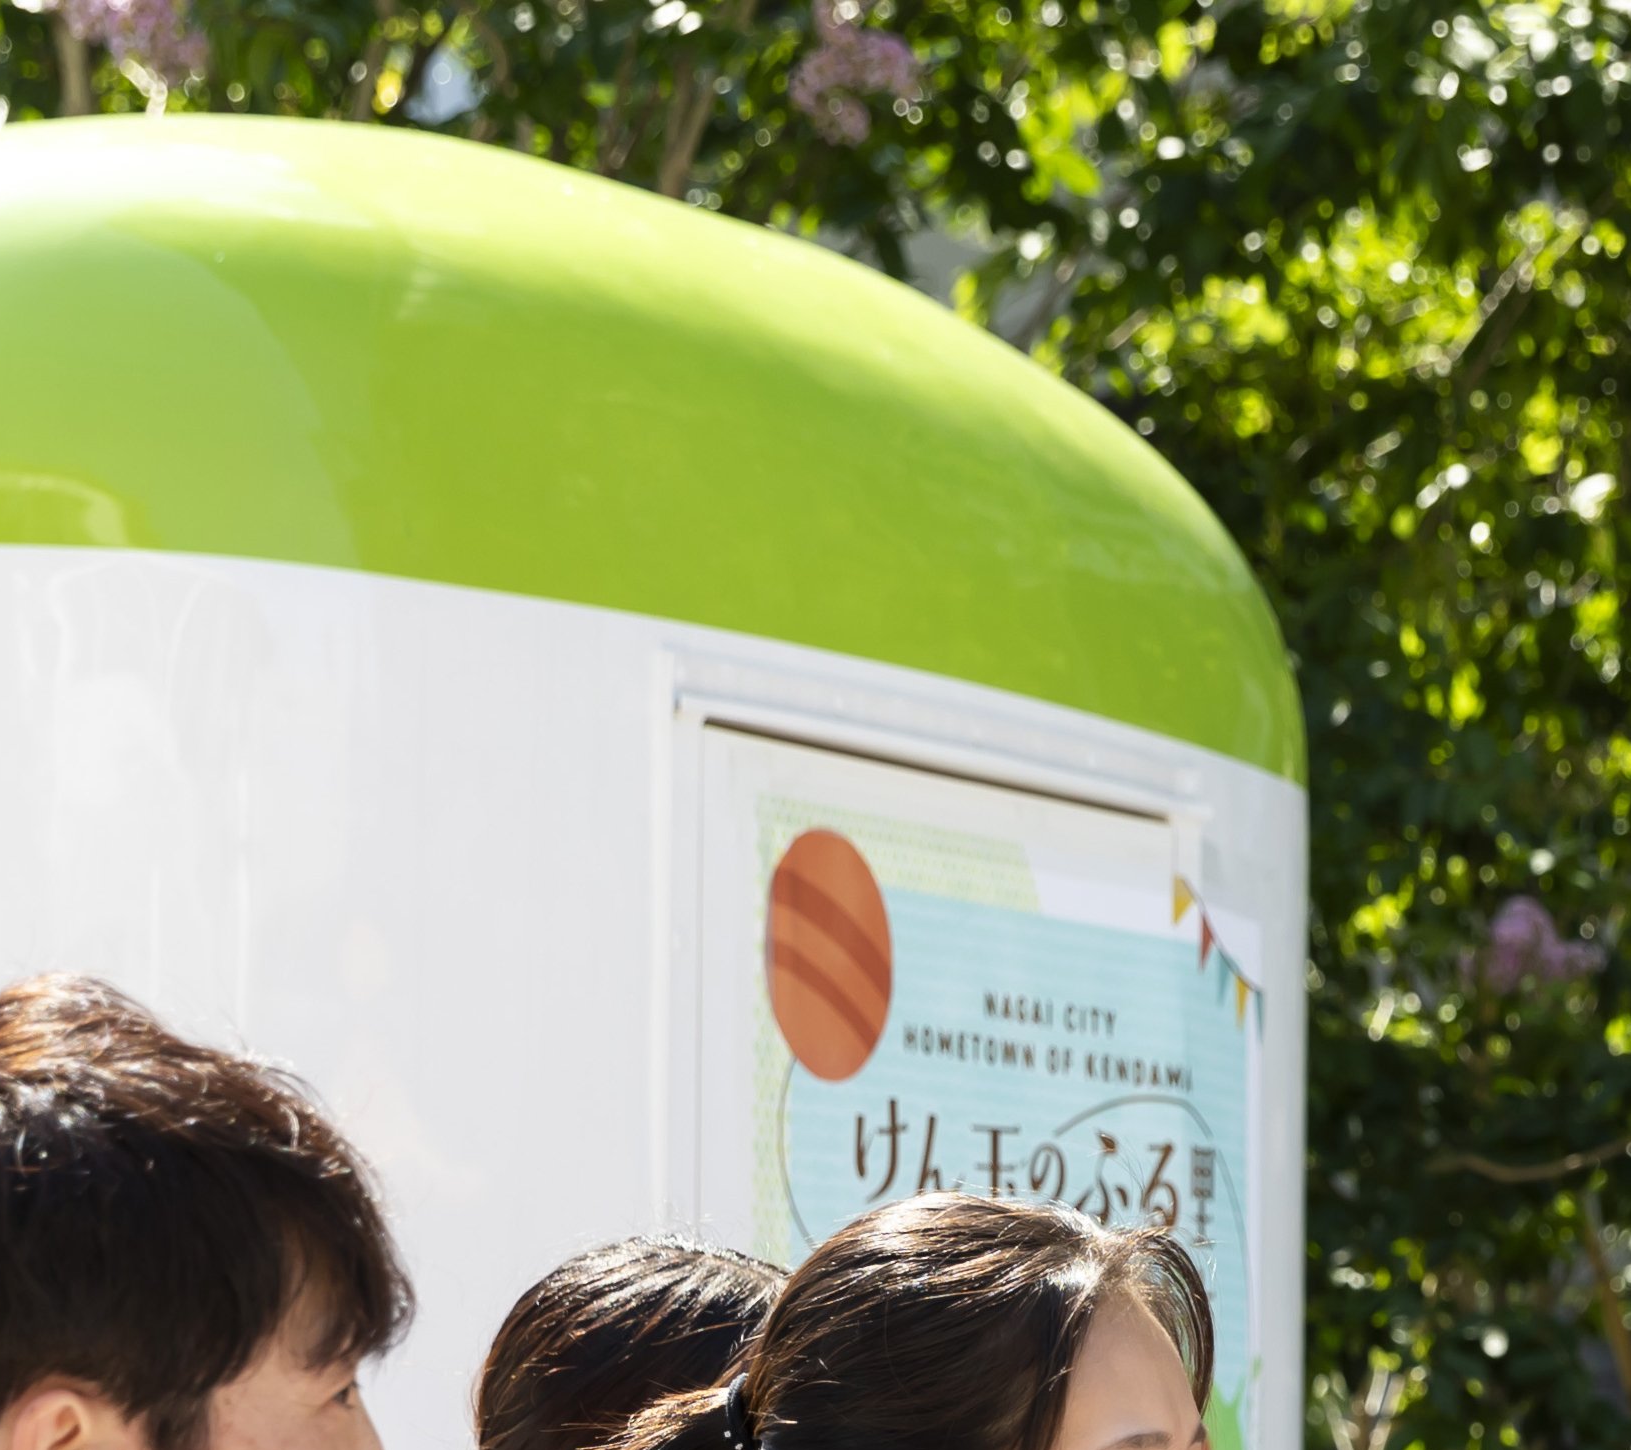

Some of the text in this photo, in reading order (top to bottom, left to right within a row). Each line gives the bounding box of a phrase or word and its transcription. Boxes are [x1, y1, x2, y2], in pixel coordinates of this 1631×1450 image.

[984, 990, 1116, 1036] NAGAI CITY
[903, 1026, 1034, 1068] HOMETOWN
[1046, 1047, 1073, 1074] OF
